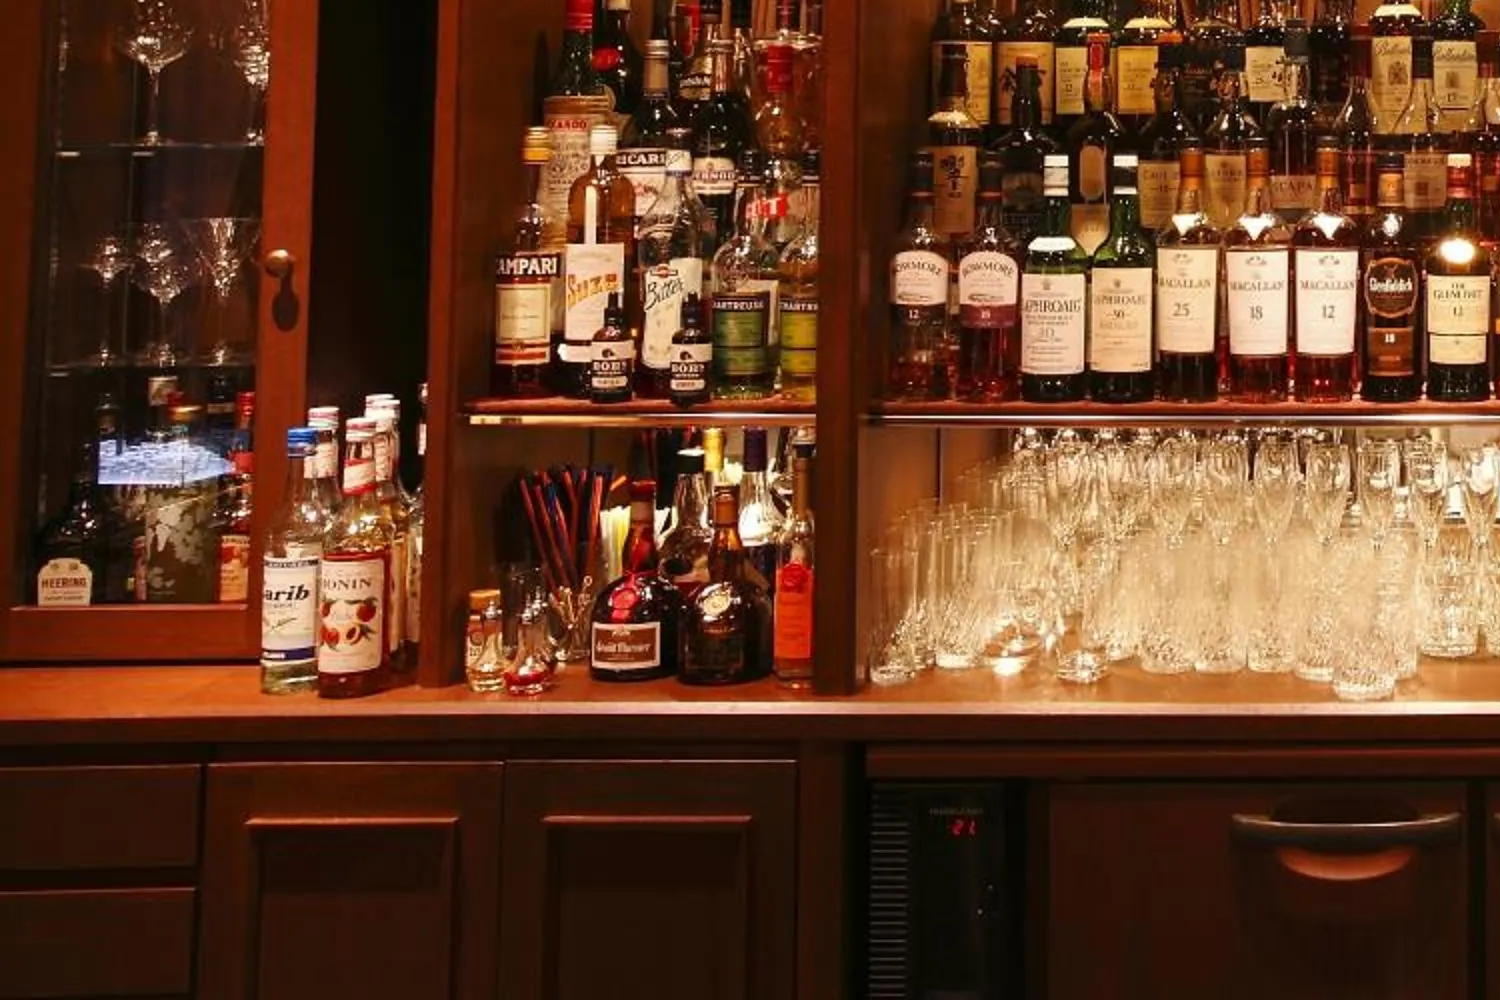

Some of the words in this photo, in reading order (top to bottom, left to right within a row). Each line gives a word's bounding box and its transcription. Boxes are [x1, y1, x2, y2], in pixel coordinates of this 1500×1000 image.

[615, 152, 667, 167] RICAR
[497, 256, 557, 275] AMPARI
[1300, 279, 1355, 291] MACALLAN
[1173, 302, 1190, 317] 25
[1250, 305, 1264, 320] 18
[1322, 305, 1335, 319] 12
[41, 576, 87, 589] HEERING
